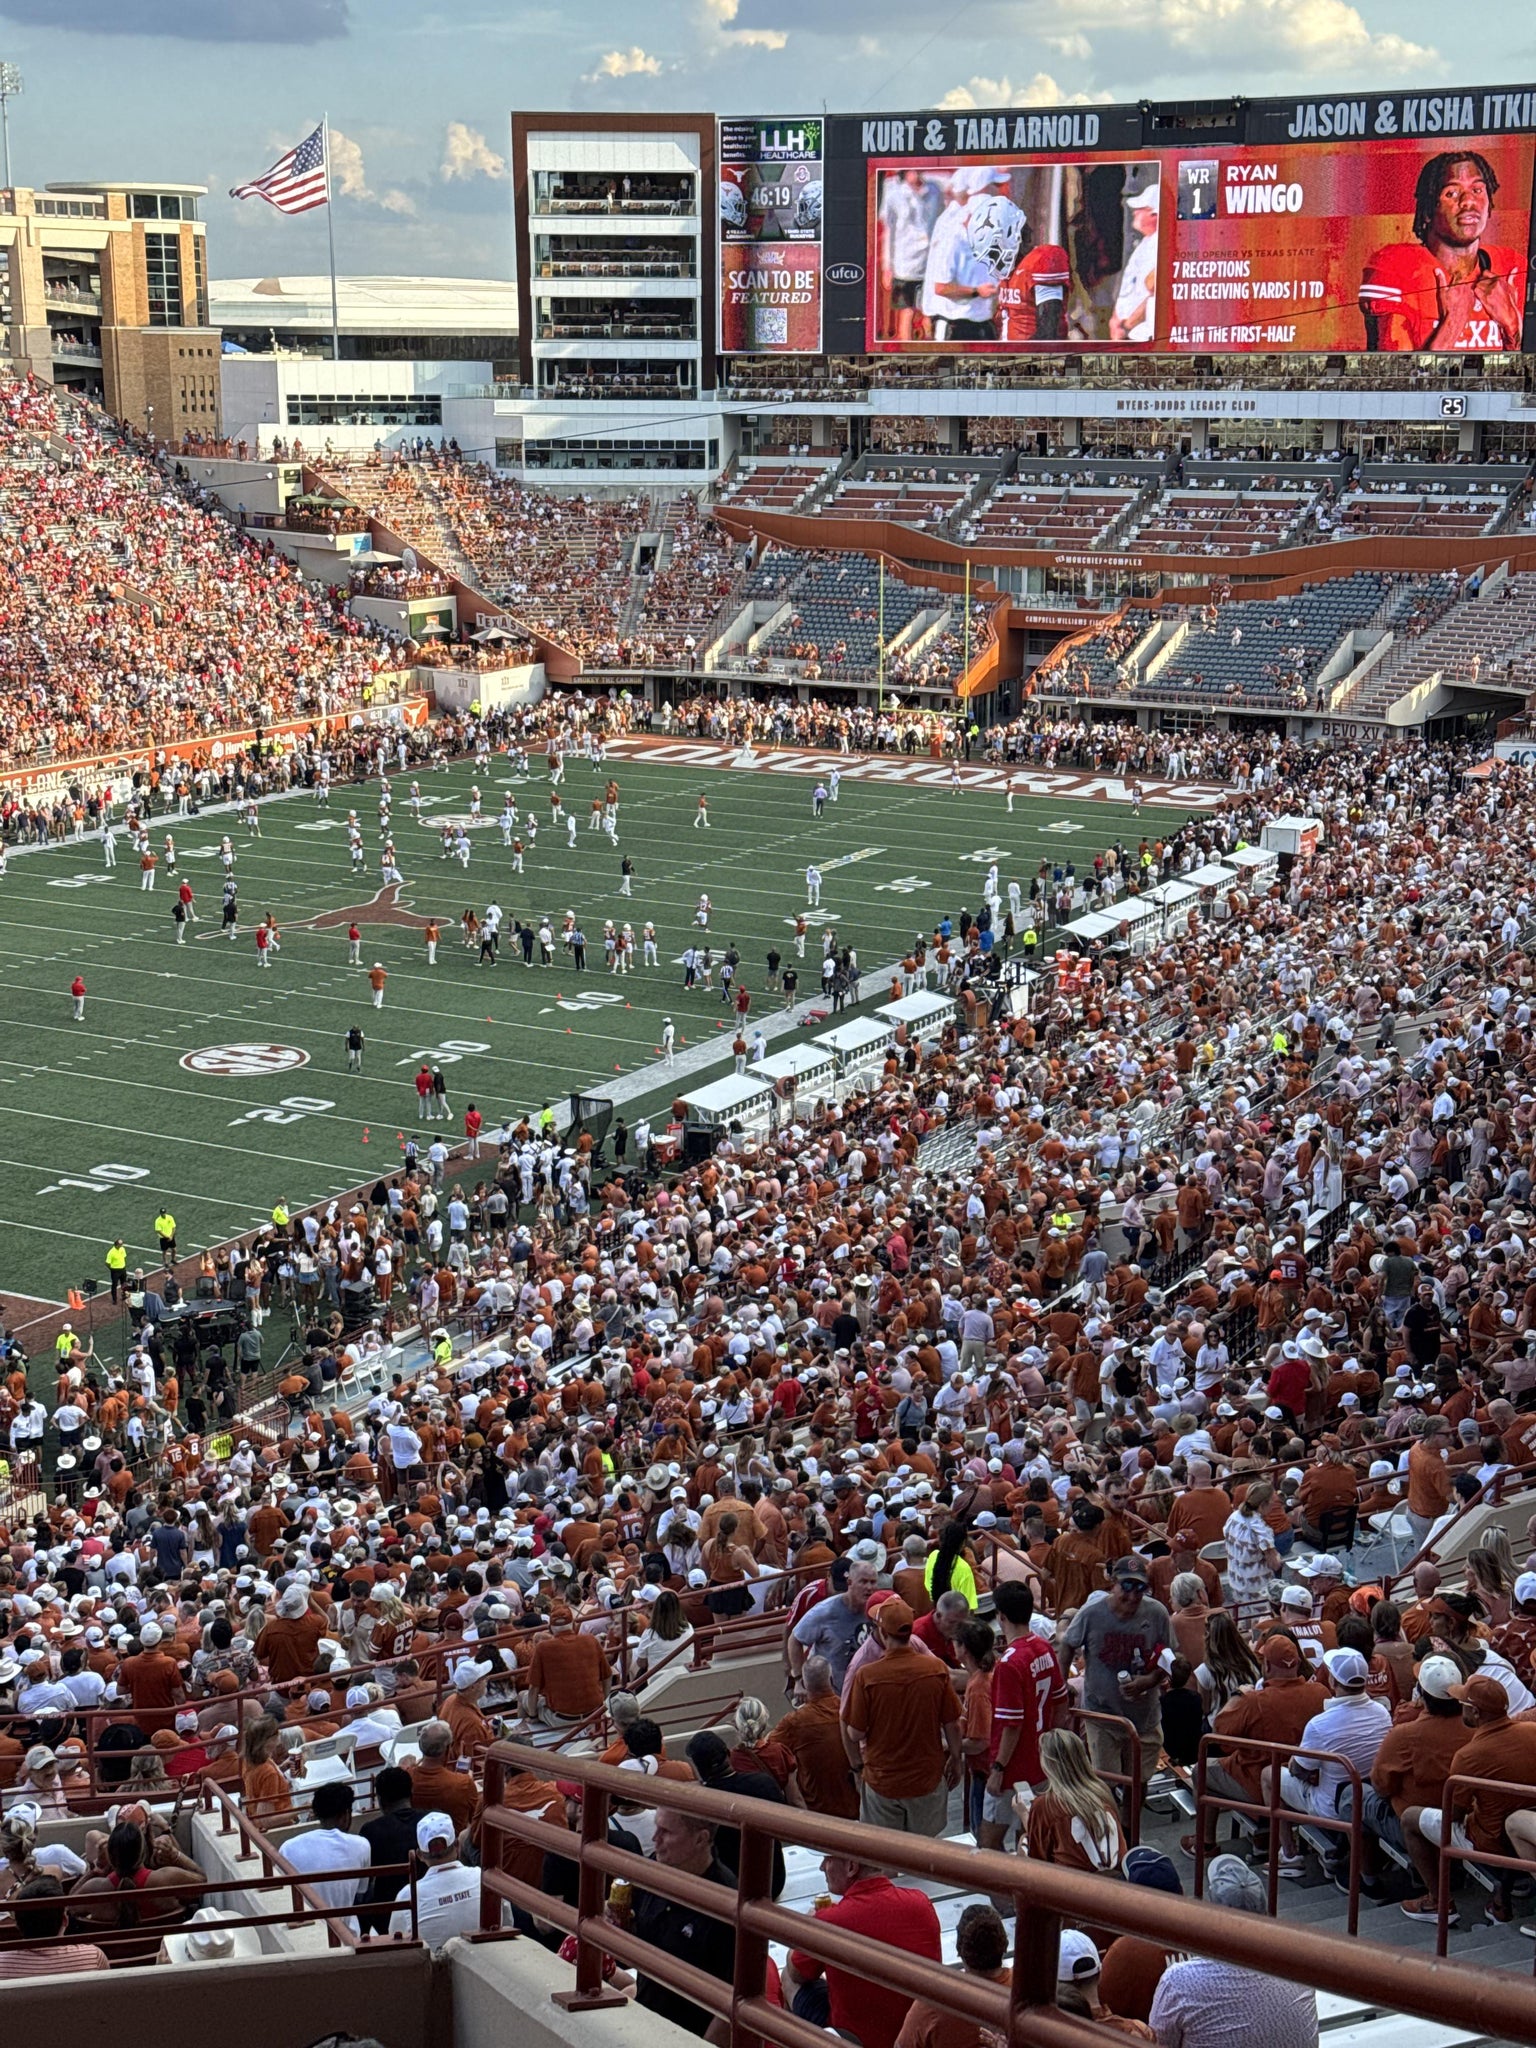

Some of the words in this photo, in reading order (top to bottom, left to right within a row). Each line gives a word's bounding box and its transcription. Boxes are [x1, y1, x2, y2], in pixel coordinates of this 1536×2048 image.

[1288, 102, 1366, 138] JASON
[1375, 100, 1398, 134] &
[1402, 96, 1474, 133] KISHA
[1482, 92, 1536, 129] ITKI
[760, 130, 804, 151] LLH
[862, 120, 917, 153] KURT
[923, 118, 946, 151] &
[954, 116, 1009, 150] TARA
[1012, 113, 1100, 149] ARNOLD
[760, 151, 816, 160] HEALTHCARE
[1187, 168, 1210, 185] WR
[1227, 164, 1277, 182] RYAN
[752, 186, 790, 206] 46:19
[1192, 188, 1201, 214] 1
[1225, 183, 1304, 214] WINGO
[1202, 251, 1238, 259] OPENER
[1241, 250, 1253, 258] VS
[1256, 249, 1284, 258] TEXAS
[1287, 248, 1315, 257] STATE
[831, 267, 858, 279] ufcu
[1173, 262, 1180, 279] 7
[1182, 261, 1250, 278] RECEPTIONS
[728, 270, 768, 290] SCAN
[771, 270, 791, 290] TO
[794, 270, 815, 290] BE
[731, 292, 812, 304] FEATURED
[1172, 283, 1188, 300] 121
[1191, 282, 1250, 300] RECEIVING
[1251, 281, 1290, 299] YARDS
[1301, 281, 1306, 298] 1
[1309, 281, 1324, 298] TD
[1169, 326, 1189, 343] ALL
[1192, 326, 1205, 343] IN
[1207, 326, 1228, 343] THE
[1230, 325, 1296, 343] FIRST-HALF
[1116, 399, 1186, 411] MYERS-DODDS
[1190, 400, 1227, 411] LEGACY
[1231, 400, 1256, 411] CLUB
[1443, 399, 1462, 414] 25
[1108, 557, 1142, 566] COMPLEX
[476, 613, 517, 630] TEXAS
[1321, 722, 1357, 739] BEVO
[1362, 726, 1379, 740] XV
[584, 738, 1252, 806] LONGHORNS
[958, 850, 1012, 862] 20
[873, 878, 932, 894] 30
[190, 1045, 301, 1074] SEC
[410, 1040, 492, 1063] 30
[244, 1096, 336, 1125] 20
[58, 1163, 151, 1192] 10
[1281, 1265, 1297, 1278] 16
[623, 1522, 642, 1540] 16
[393, 1630, 414, 1655] 83
[1035, 1676, 1052, 1732] 7
